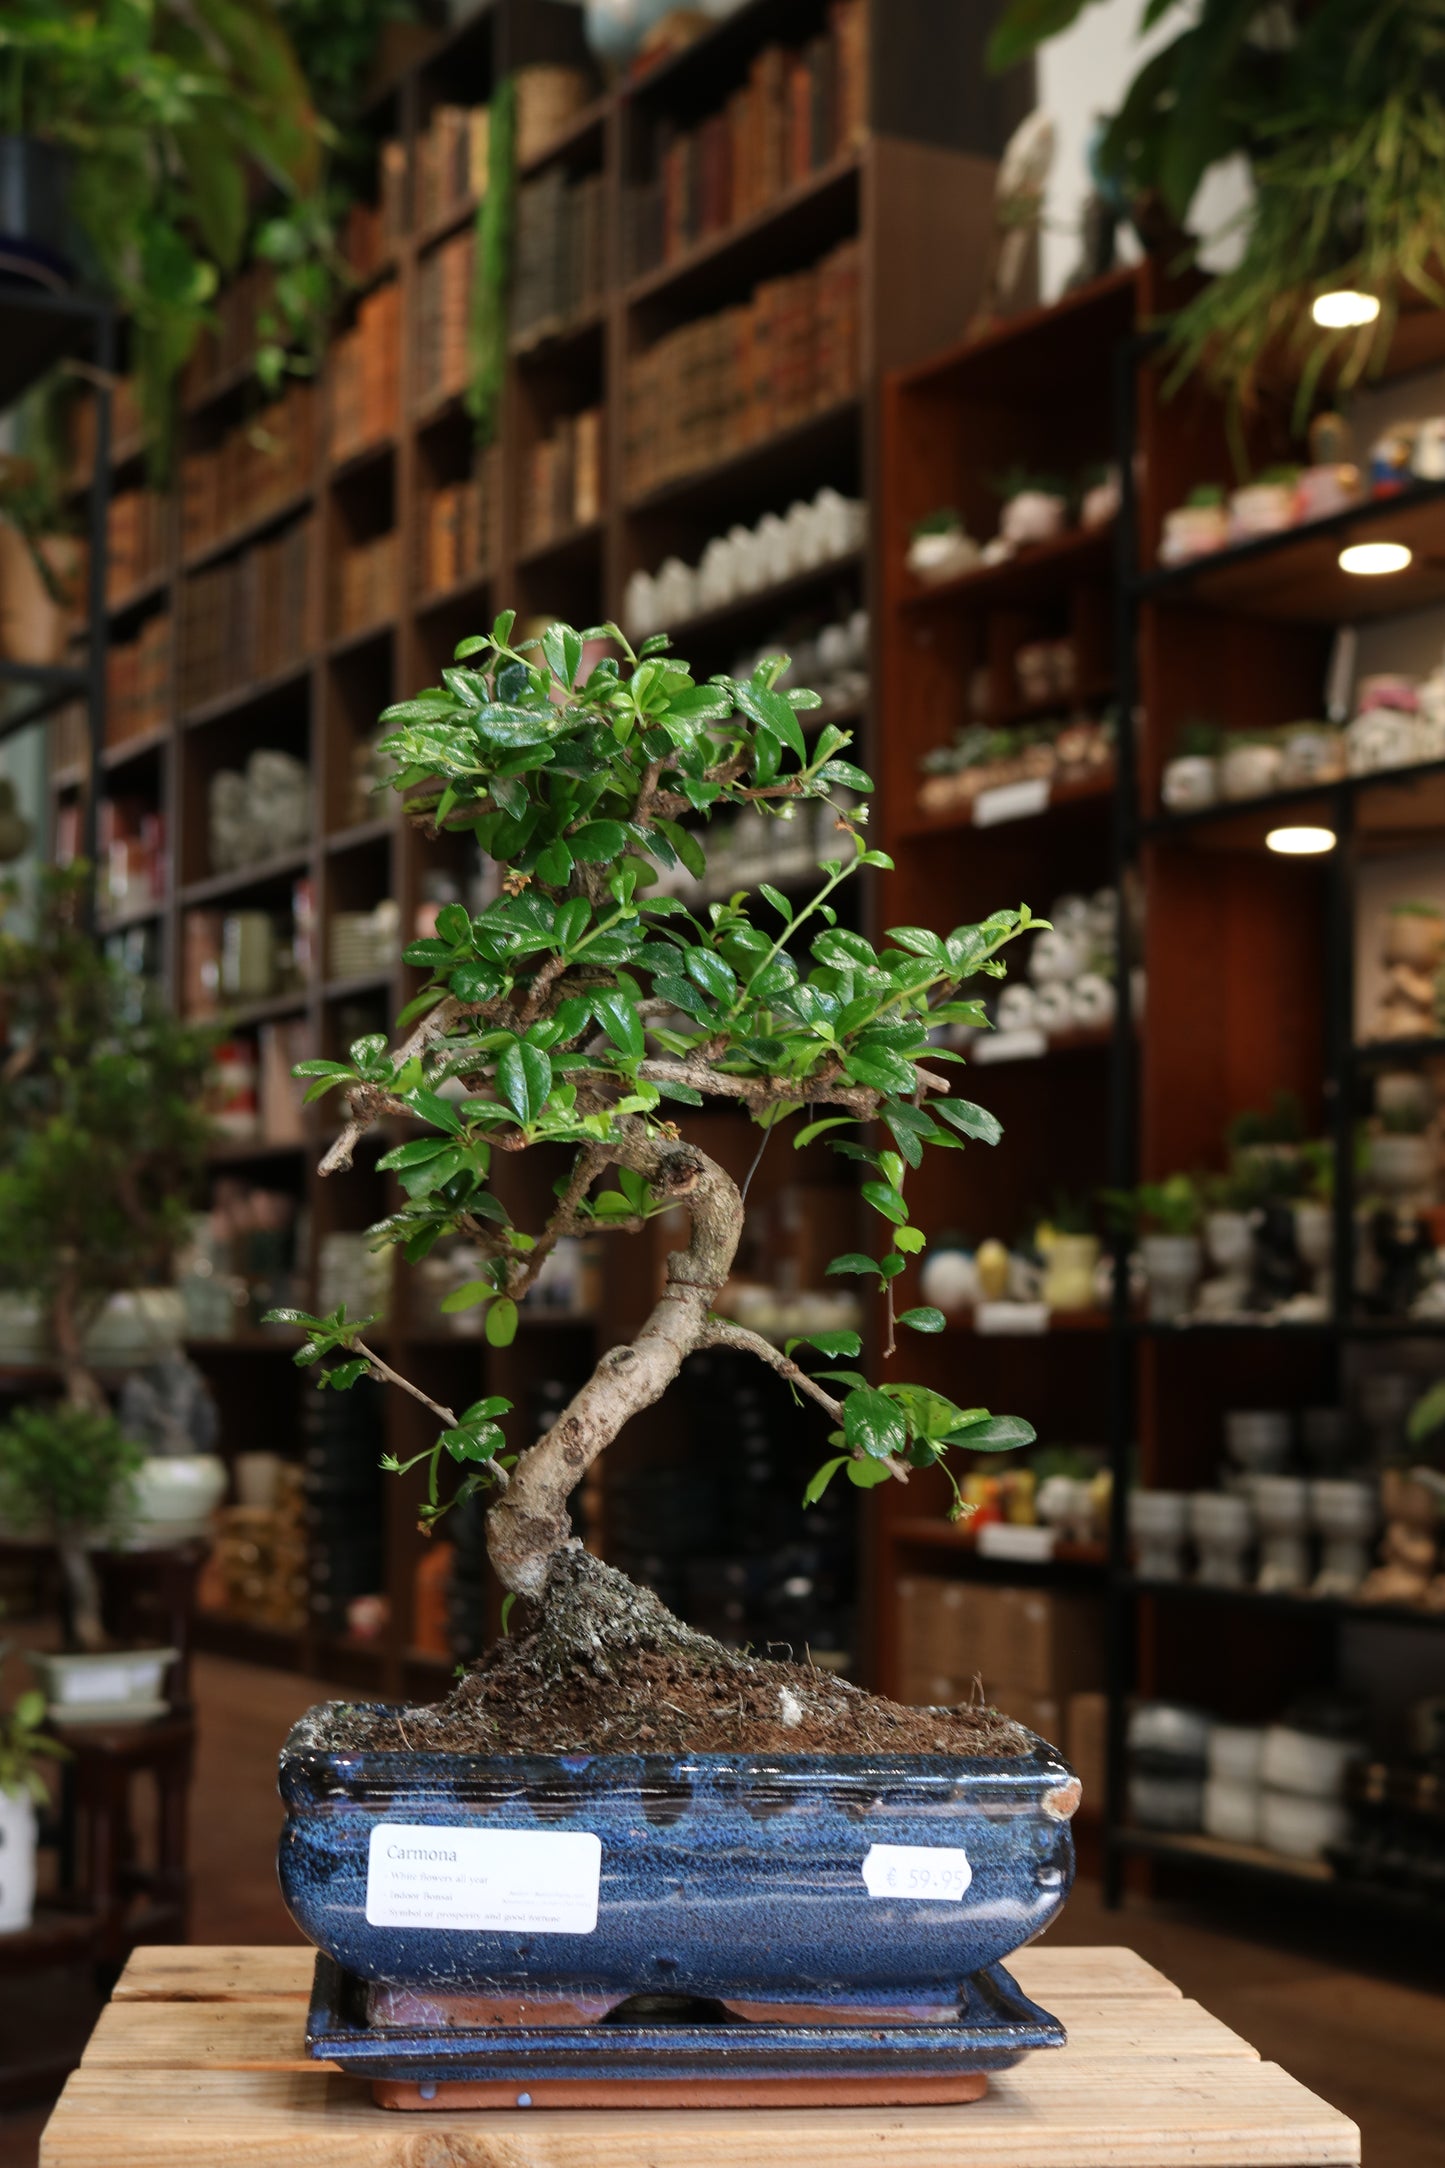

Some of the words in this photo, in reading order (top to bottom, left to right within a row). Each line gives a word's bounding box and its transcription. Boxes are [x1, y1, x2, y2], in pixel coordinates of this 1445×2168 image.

[387, 1844, 457, 1862] Carmona
[391, 1871, 416, 1882] White
[420, 1872, 453, 1884] flowers
[456, 1874, 466, 1884] all
[469, 1877, 488, 1886] year
[886, 1866, 896, 1887] €
[908, 1869, 963, 1890] 59.95
[390, 1891, 419, 1901] Indoor
[423, 1892, 453, 1902] Bonsai
[388, 1907, 422, 1919] Symbol
[424, 1910, 434, 1918] of
[436, 1911, 480, 1921] prosperity
[484, 1912, 502, 1921] and
[504, 1913, 525, 1923] good
[528, 1914, 561, 1923] fortune
